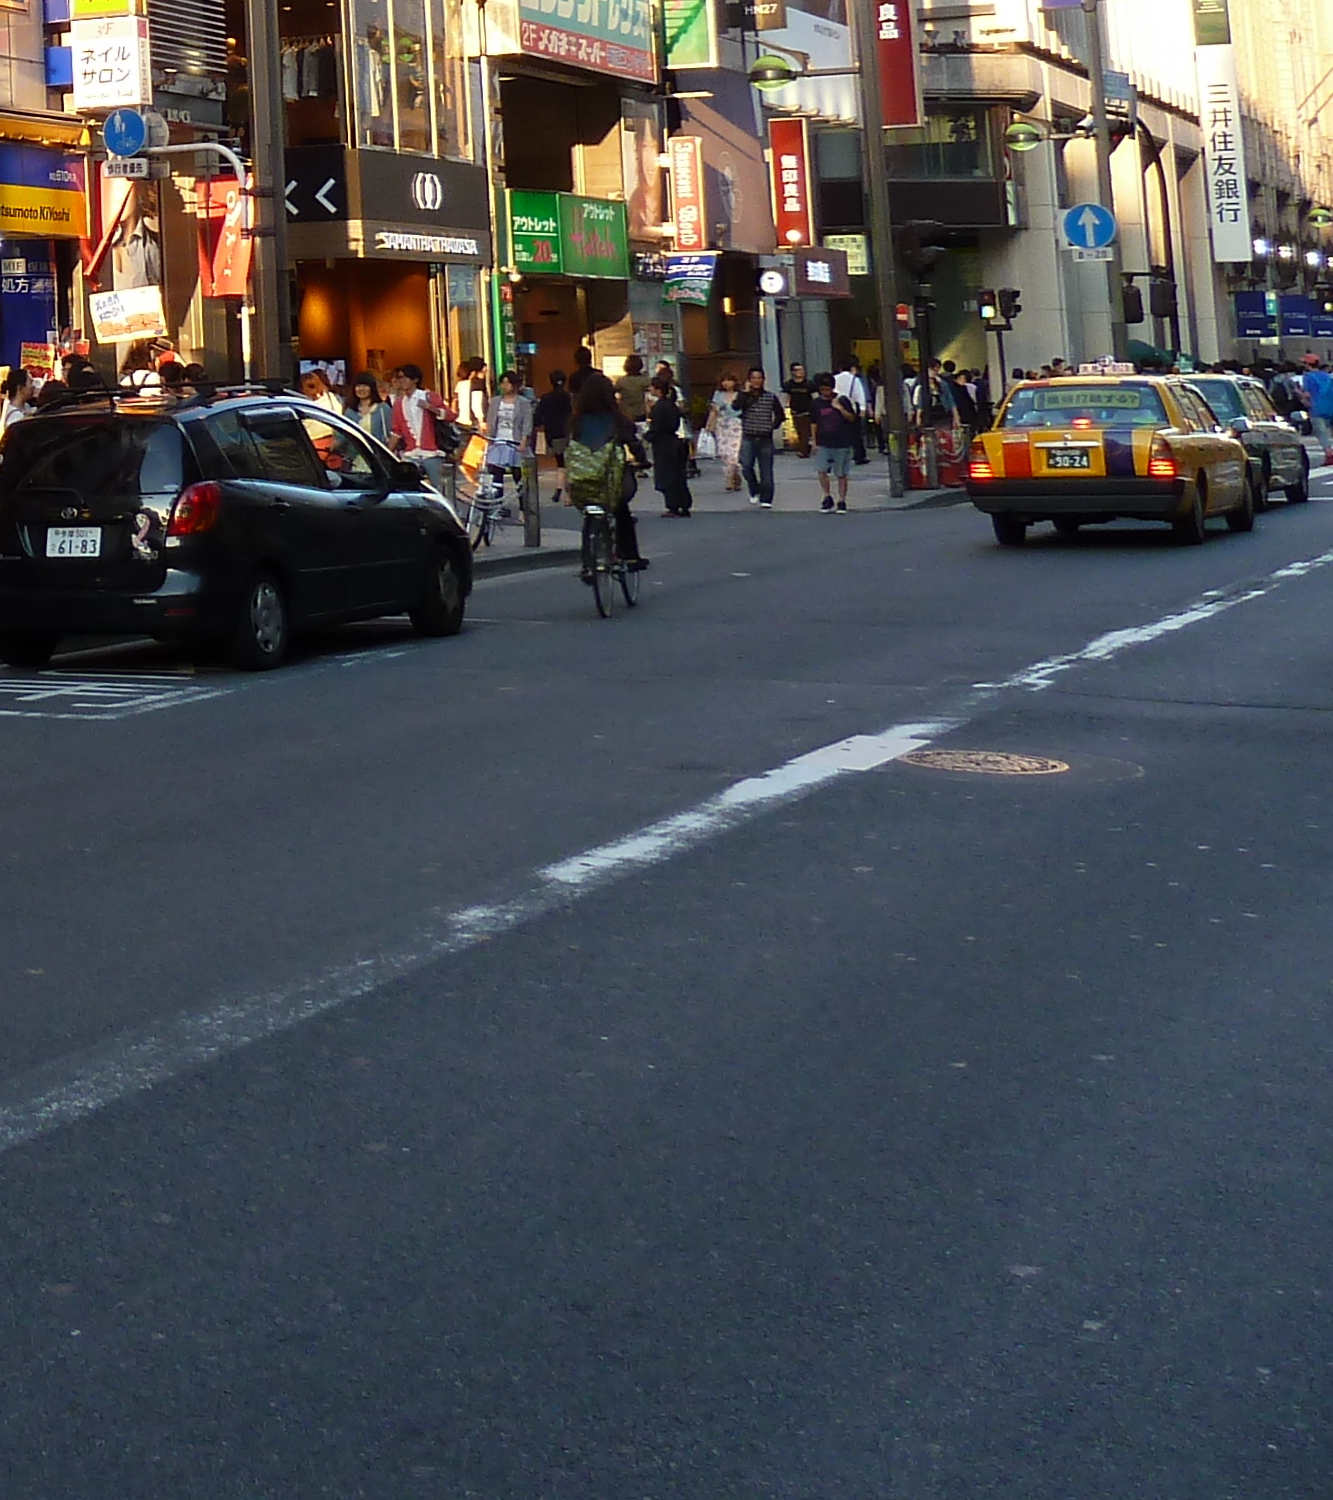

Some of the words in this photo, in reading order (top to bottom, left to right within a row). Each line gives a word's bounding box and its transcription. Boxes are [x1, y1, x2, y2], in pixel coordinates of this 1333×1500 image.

[522, 23, 537, 46] 2F
[80, 48, 131, 64] ネイル
[80, 69, 132, 84] サロン
[1207, 83, 1242, 224] 三井住友銀行
[107, 162, 145, 175] 歩行者優先
[781, 155, 801, 212] 無印良品
[38, 205, 71, 223] KiYoshi
[513, 216, 557, 232] アウトレット
[375, 231, 435, 253] SAMANTHA
[533, 239, 551, 263] 20
[1056, 456, 1088, 466] 90-24
[58, 540, 97, 554] 61-83
